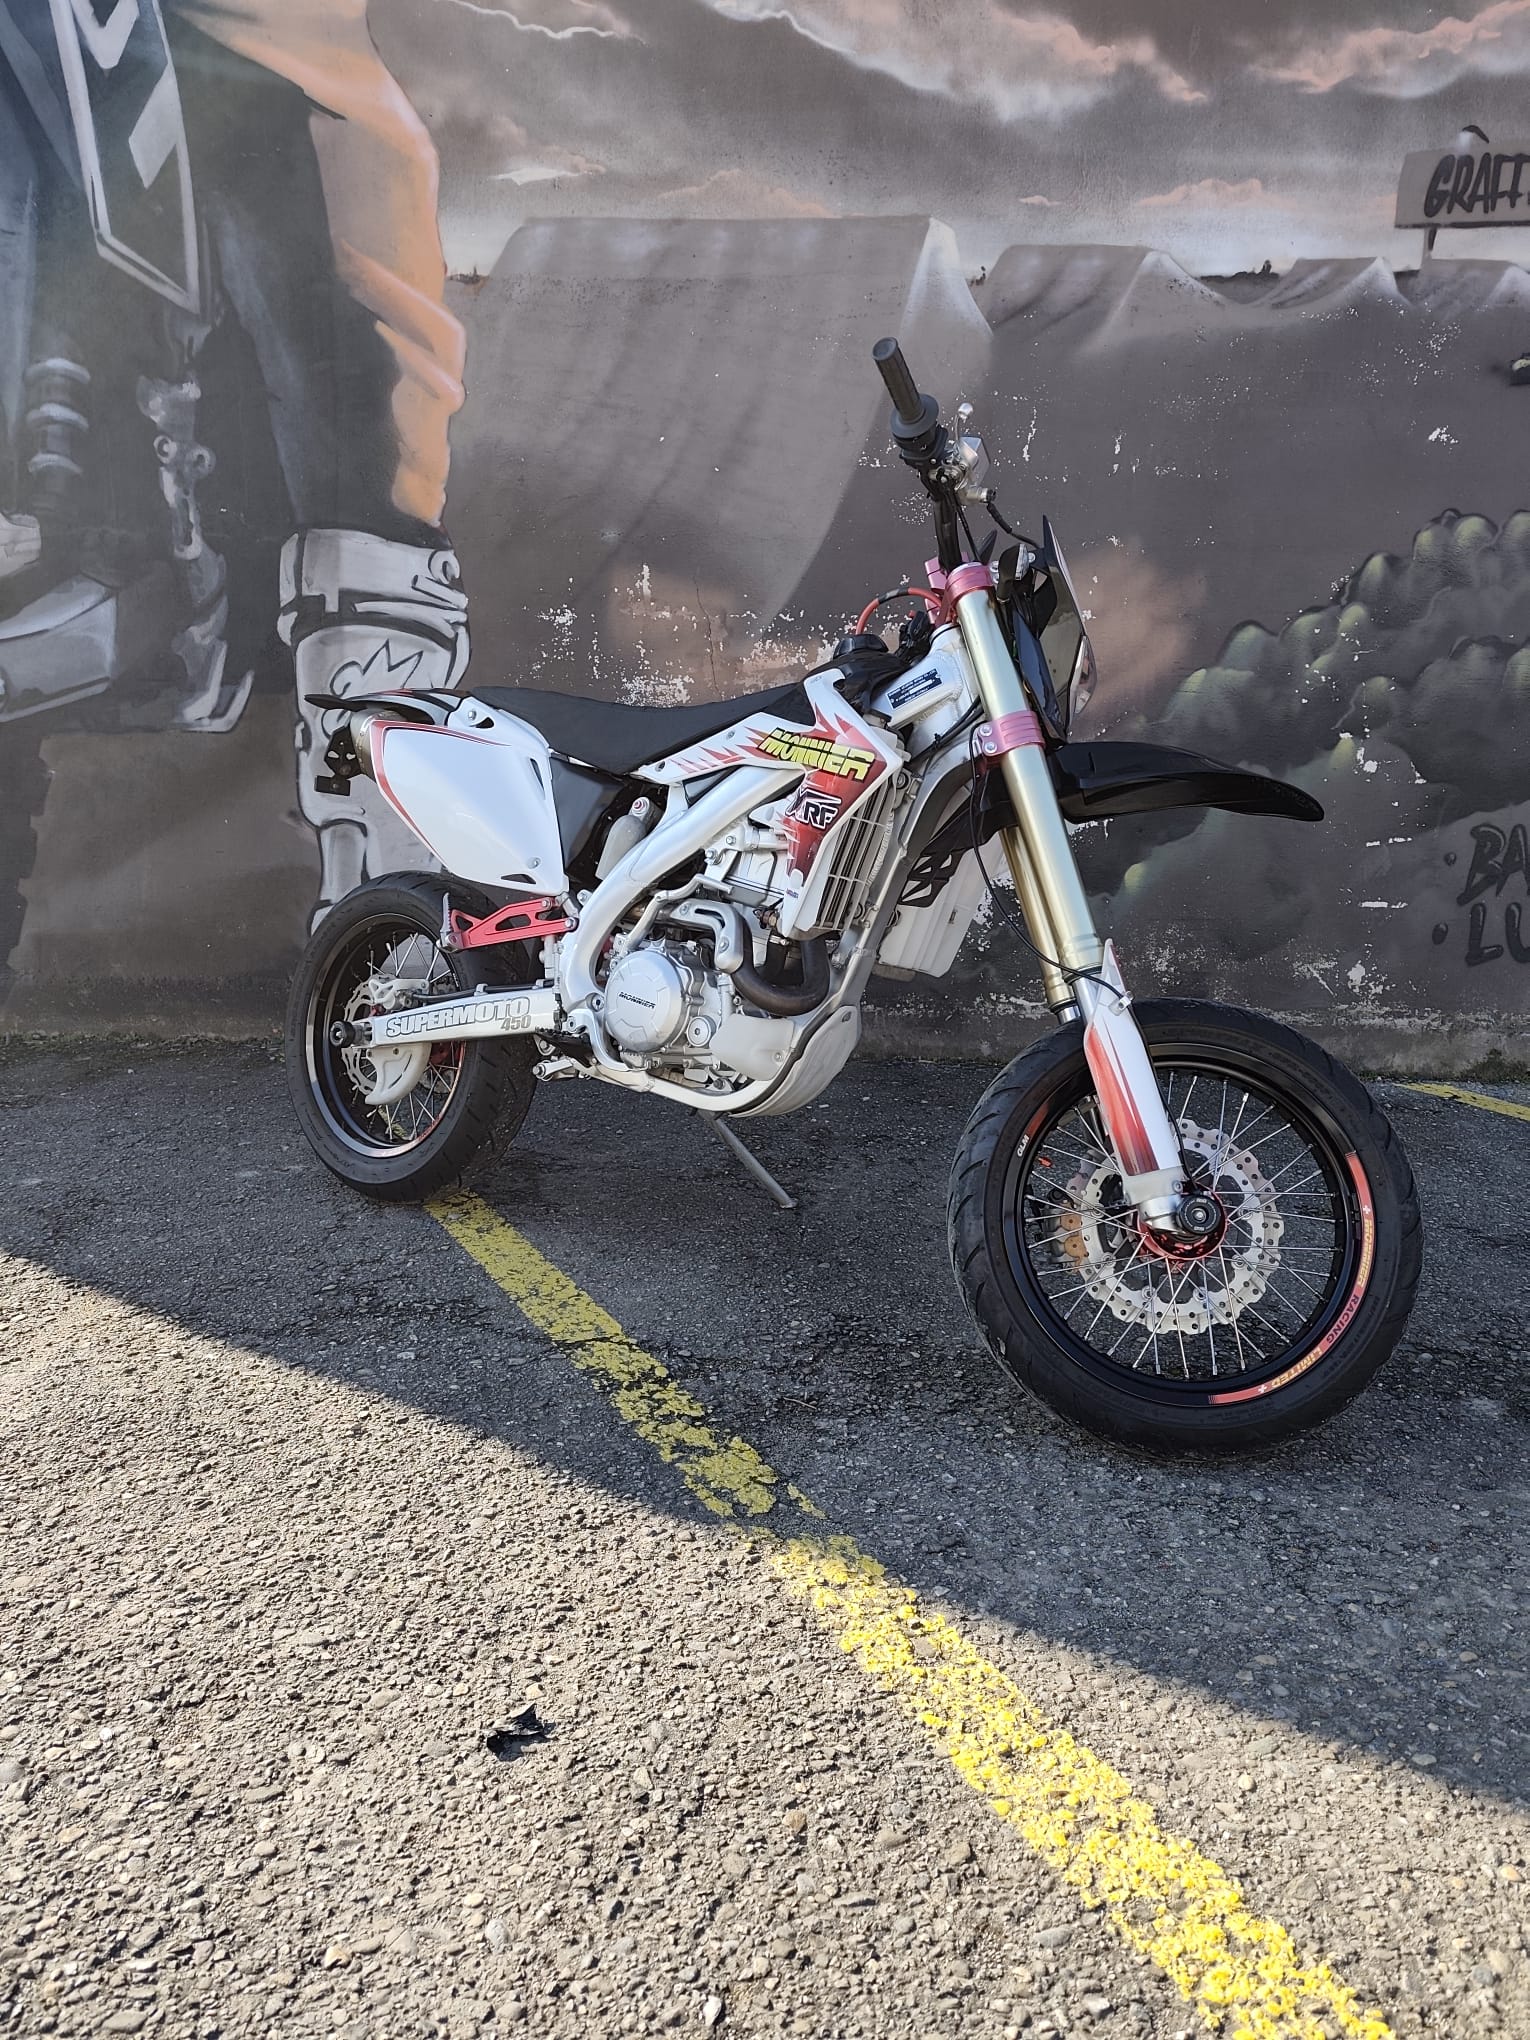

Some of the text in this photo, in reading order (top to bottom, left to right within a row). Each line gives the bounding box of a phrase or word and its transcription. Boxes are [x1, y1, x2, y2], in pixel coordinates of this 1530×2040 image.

[1424, 152, 1530, 217] GRAFF
[758, 727, 876, 782] MONNIER
[386, 996, 530, 1038] SUPERMOTO
[500, 1014, 532, 1031] 450
[1326, 1294, 1360, 1344] RACING
